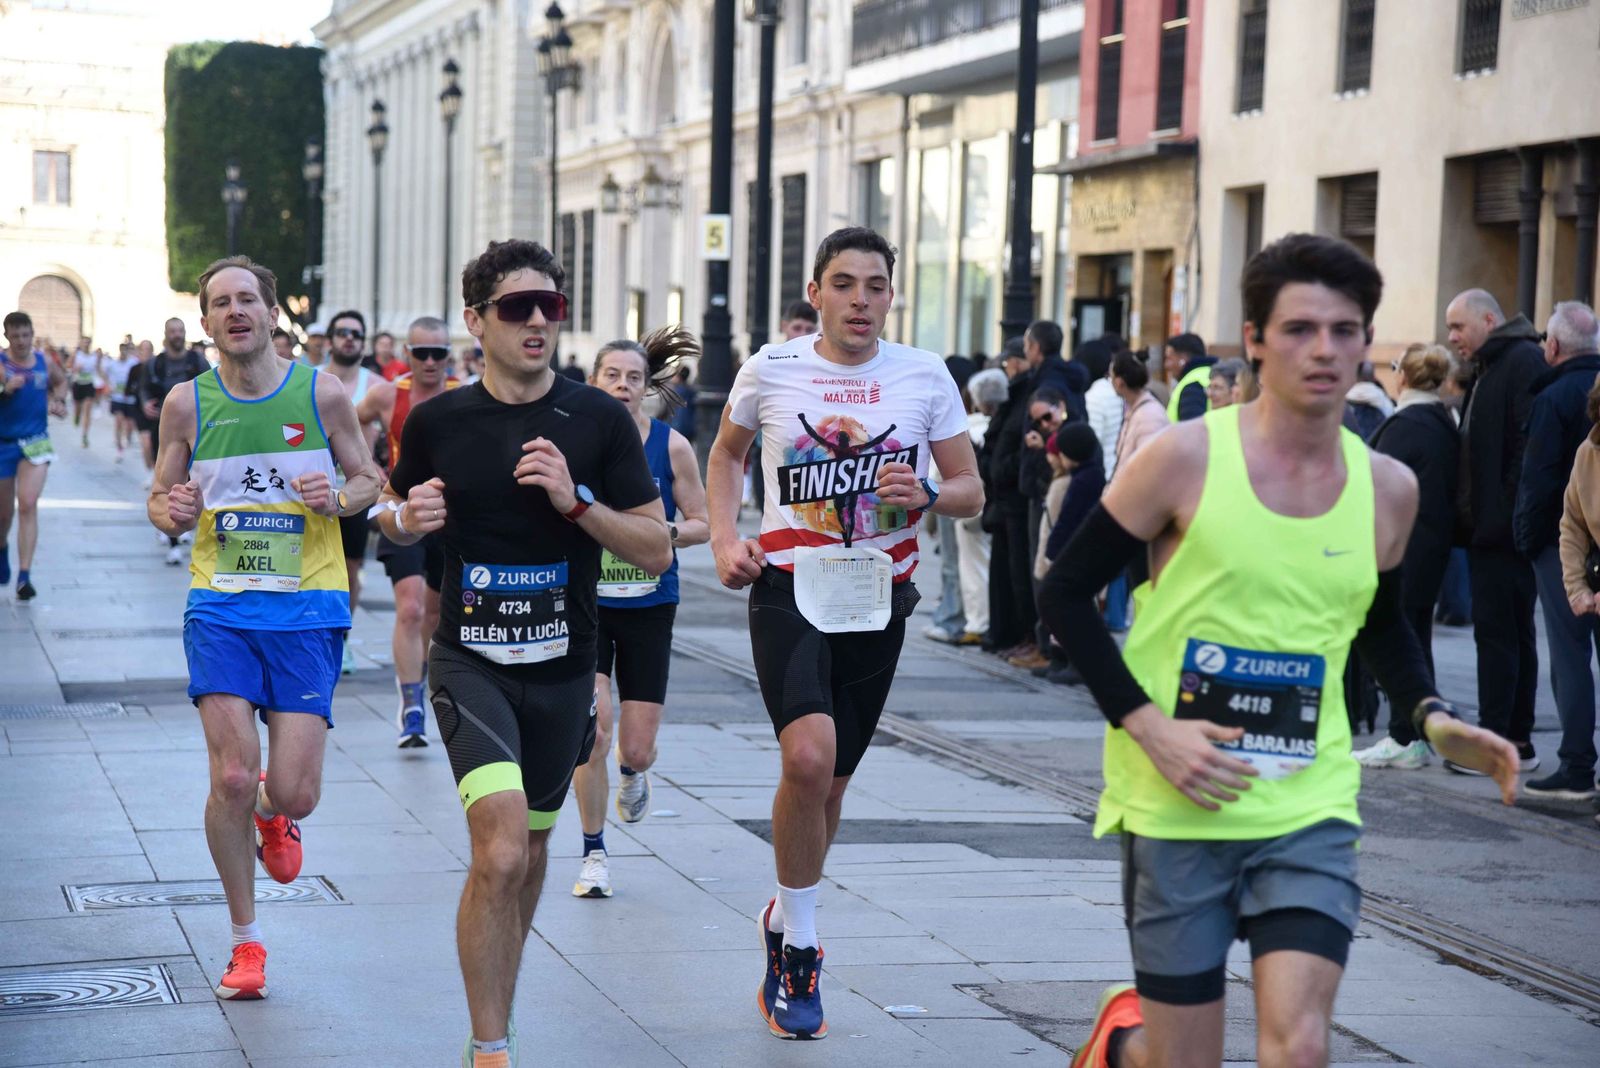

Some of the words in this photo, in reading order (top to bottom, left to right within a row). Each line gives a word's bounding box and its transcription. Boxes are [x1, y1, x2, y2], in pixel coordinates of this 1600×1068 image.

[709, 225, 723, 249] 5
[825, 378, 866, 388] GENERALI
[823, 391, 867, 404] MÁLAGA
[243, 516, 293, 529] ZURICH
[243, 539, 270, 551] 2884
[236, 555, 277, 572] AXEL
[497, 570, 556, 585] ZURICH
[498, 600, 532, 615] 4734
[460, 623, 508, 643] BELÉN
[512, 626, 523, 642] Y
[527, 618, 569, 641] LUCÍA
[1232, 655, 1311, 678] ZURICH
[1228, 693, 1273, 715] 4418
[1242, 732, 1317, 757] BARAJAS
